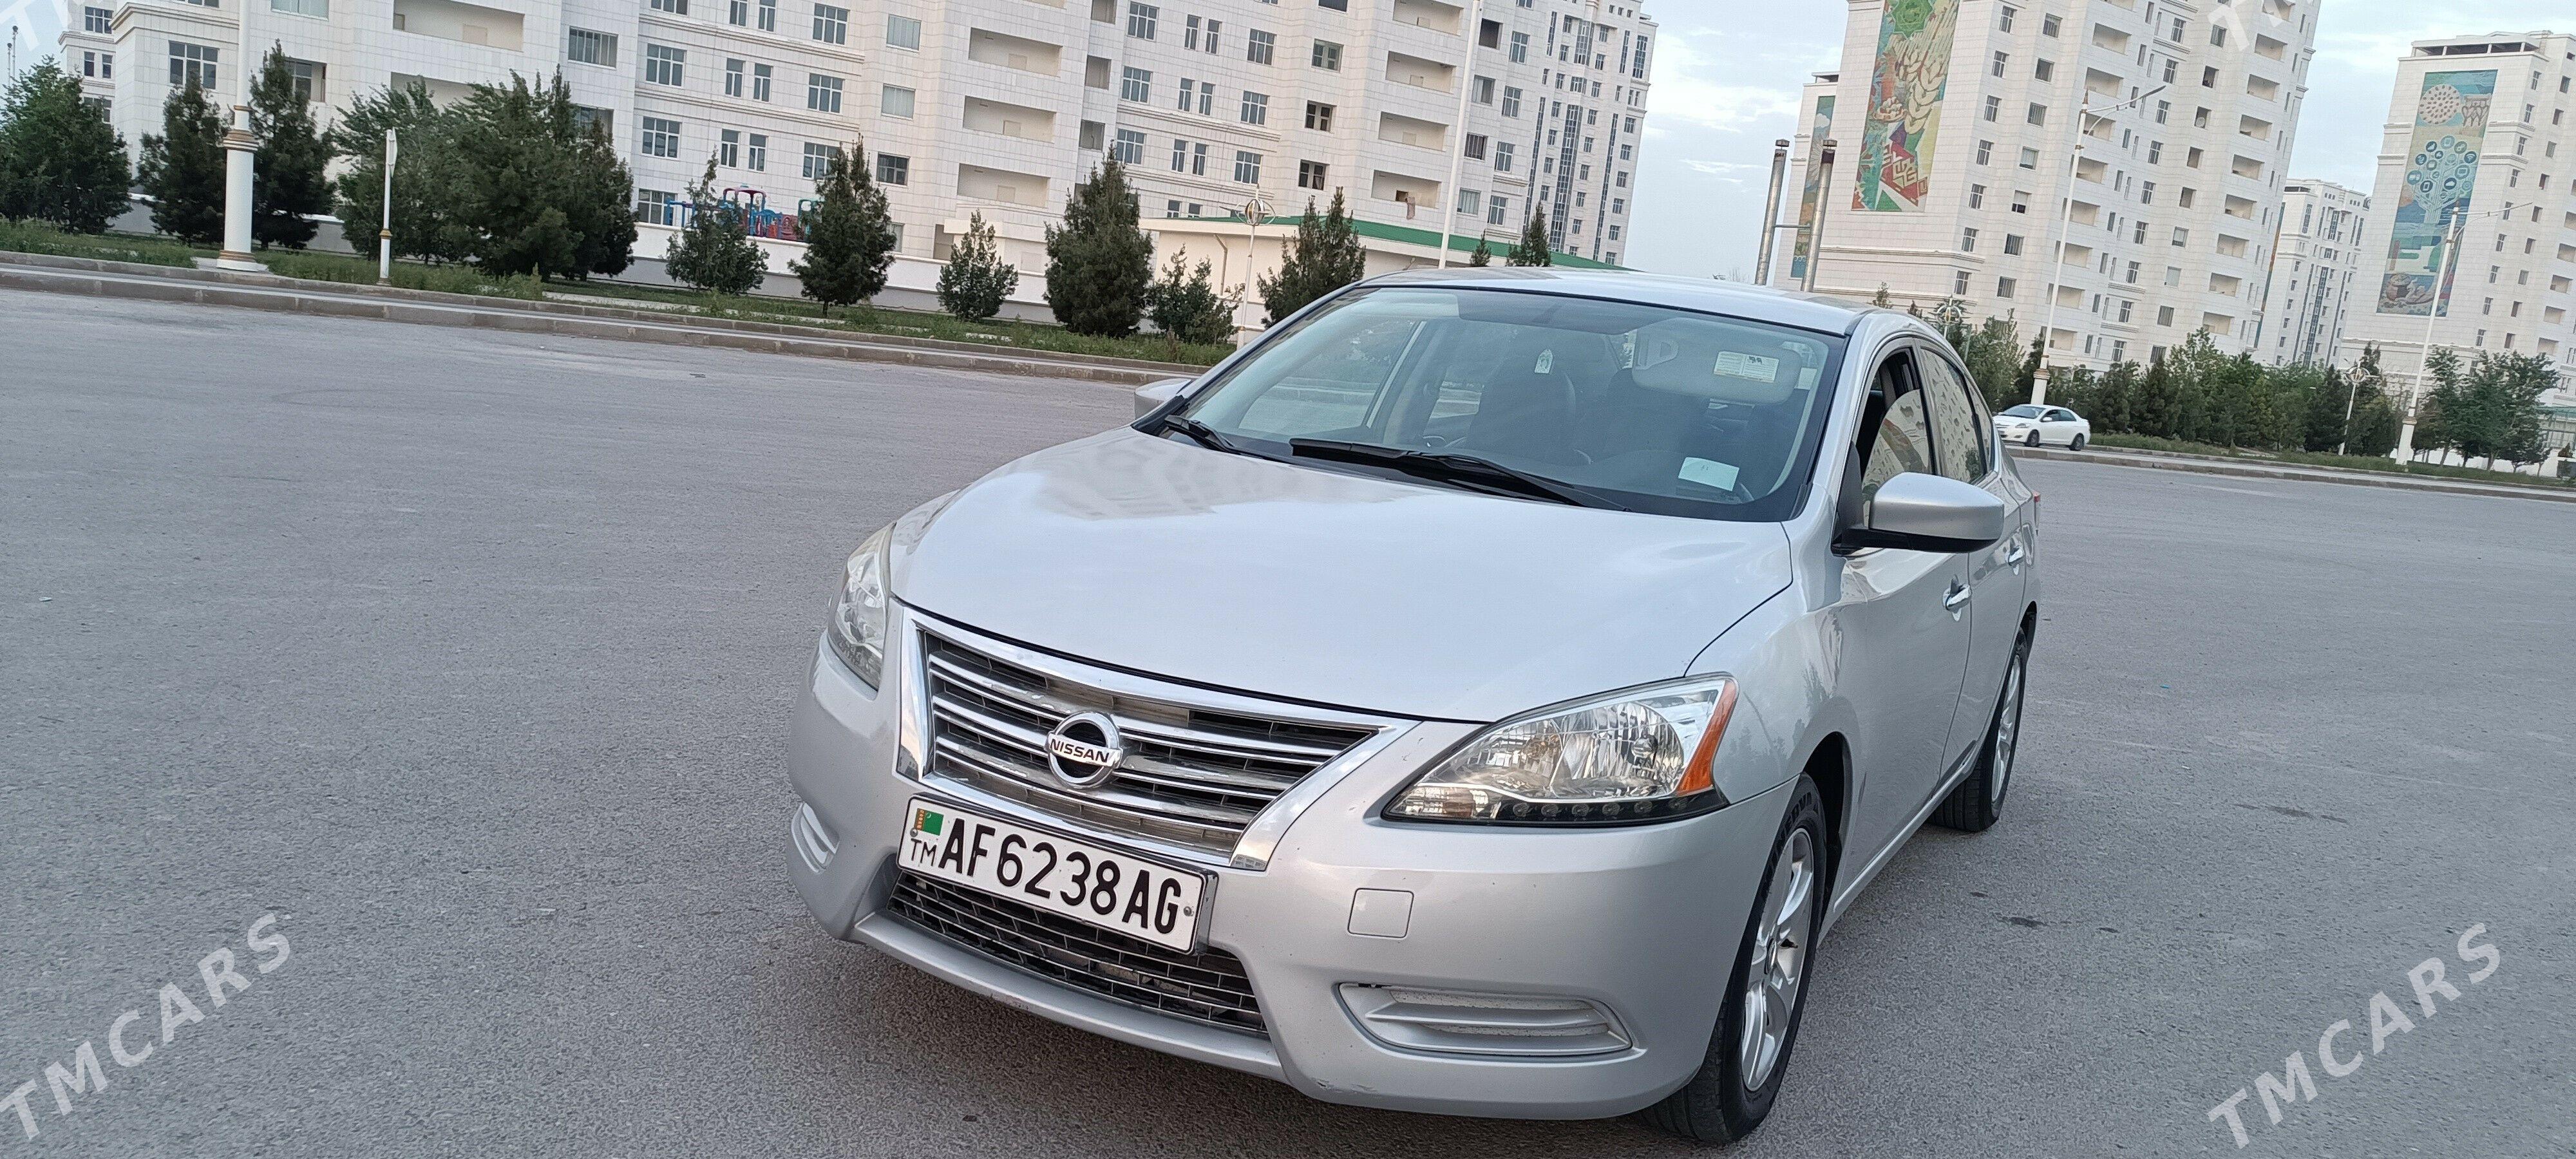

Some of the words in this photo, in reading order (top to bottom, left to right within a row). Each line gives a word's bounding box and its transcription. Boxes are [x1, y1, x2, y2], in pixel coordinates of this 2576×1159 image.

[1050, 739, 1109, 763] NISSAN
[911, 838, 937, 866] TM
[938, 818, 1181, 934] AF6238AG
